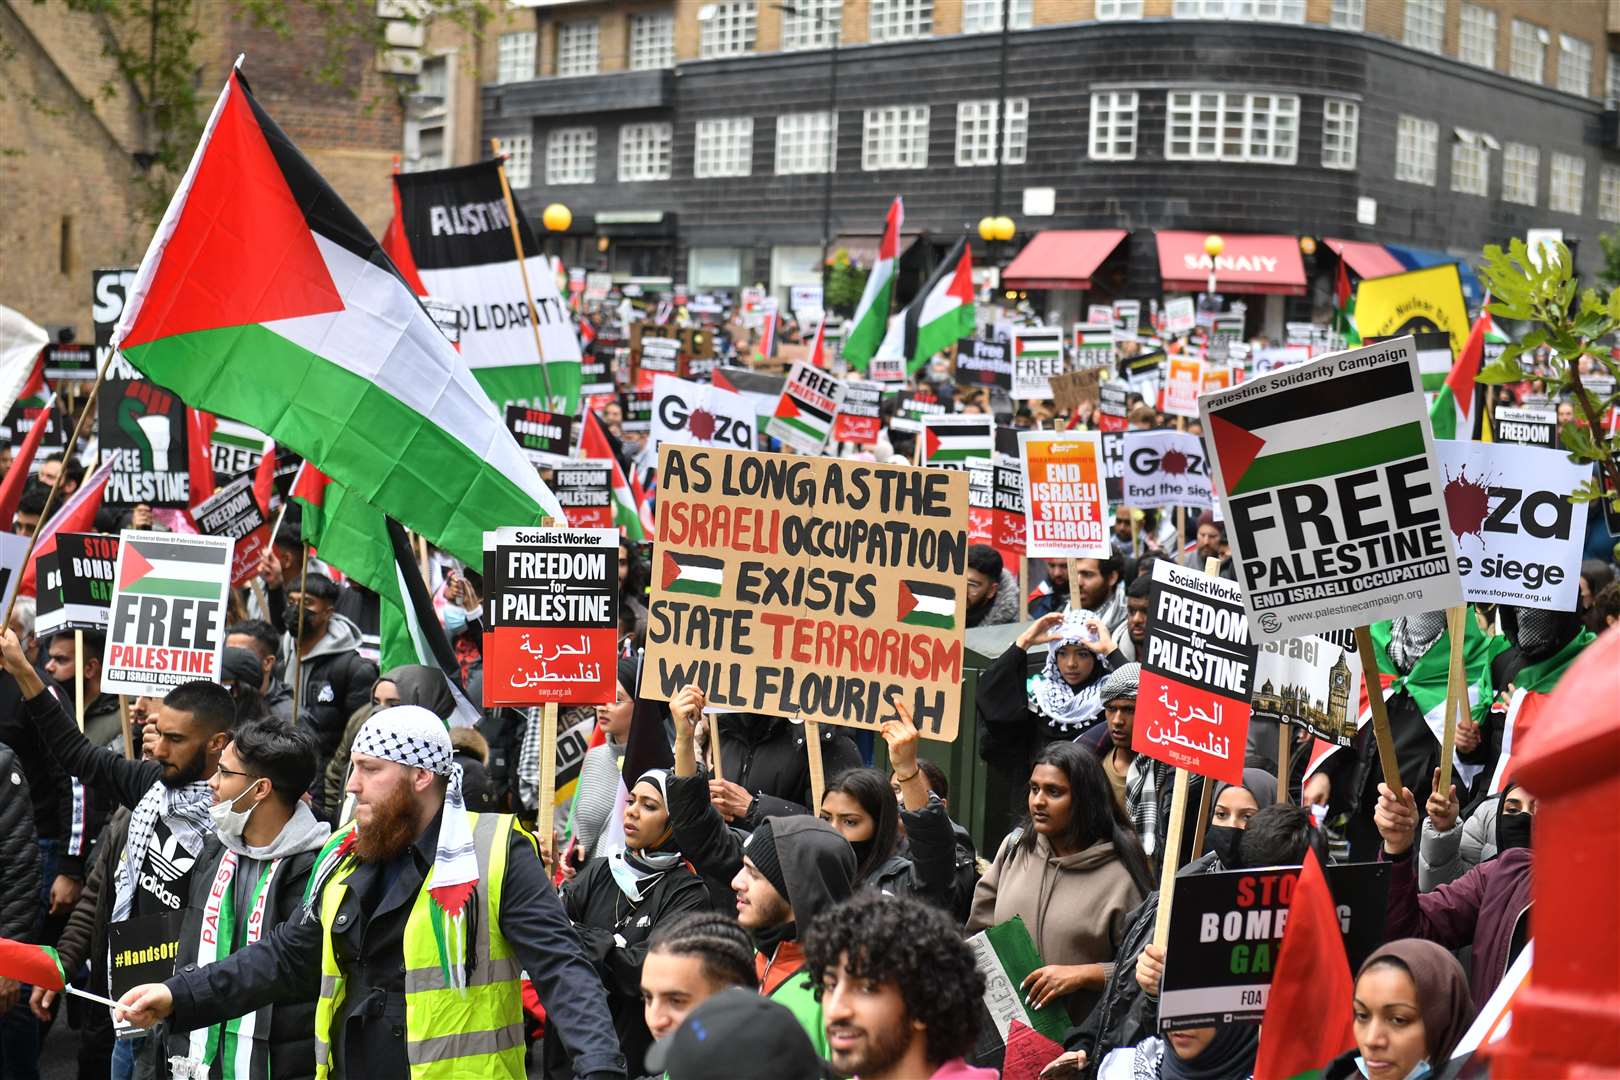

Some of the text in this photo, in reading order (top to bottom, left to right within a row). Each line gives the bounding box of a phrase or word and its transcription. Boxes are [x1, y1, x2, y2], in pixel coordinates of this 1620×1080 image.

[1184, 254, 1278, 272] SANAIY
[93, 272, 138, 323] ST
[459, 297, 564, 332] OLIDARTY
[1016, 359, 1060, 376] FREE
[1207, 383, 1268, 409] Palestine
[1271, 364, 1334, 391] Solidarity
[1338, 348, 1408, 373] Campaign
[798, 367, 839, 399] FREE
[1500, 422, 1549, 443] FREEDOM
[558, 471, 607, 486] FREEDOM
[663, 450, 951, 517] AS LONG AS THE
[970, 470, 993, 485] FREE
[998, 470, 1024, 488] FREE
[1046, 463, 1080, 482] END
[995, 492, 1025, 512] PALES
[1032, 483, 1097, 502] ISRAELI
[1128, 484, 1155, 497] End
[1160, 482, 1183, 495] the
[203, 490, 251, 533] FREEDOM
[1041, 502, 1092, 521] STATE
[1229, 457, 1440, 560] FREE
[221, 510, 262, 540] LESTINE
[515, 532, 602, 545] Socialist Worker
[659, 500, 780, 554] ISRAELI
[782, 514, 966, 576] OCCUPATION
[1034, 521, 1102, 540] TERROR
[73, 557, 117, 580] BOMB
[508, 552, 606, 580] FREEDOM
[1243, 523, 1446, 591] PALESTINE
[1480, 553, 1565, 590] siege
[550, 580, 567, 593] for
[736, 561, 877, 618] EXISTS
[1168, 570, 1243, 604] Socialist Worke
[1254, 592, 1285, 611] END
[1288, 579, 1349, 603] ISRAELI
[1352, 559, 1448, 591] OCCUPATION
[1467, 588, 1552, 603] www.stopwar.org.uk
[502, 593, 611, 622] PALESTINE
[1157, 590, 1249, 645] FREEDOM
[1287, 588, 1424, 624] www.palestinecampaign.org
[112, 594, 219, 650] FREE
[519, 633, 591, 661] الحرية
[649, 600, 961, 684] STATE TERRORISM
[1190, 632, 1207, 651] for
[109, 645, 214, 674] PALESTINE
[510, 661, 601, 687] لفلسطين
[1148, 635, 1249, 694] PALESTINE
[109, 670, 126, 680] END
[127, 671, 157, 683] ISRAELI
[658, 657, 945, 734] WILL FLOURISH
[1158, 685, 1223, 727] الحرية
[1146, 719, 1230, 760] لفلسطين
[1338, 736, 1351, 747] FOA
[203, 848, 238, 945] PALESTI
[1236, 875, 1299, 907] STO
[1200, 904, 1351, 943] BOMBG
[1229, 944, 1283, 975] GA
[1241, 990, 1262, 1005] FOA
